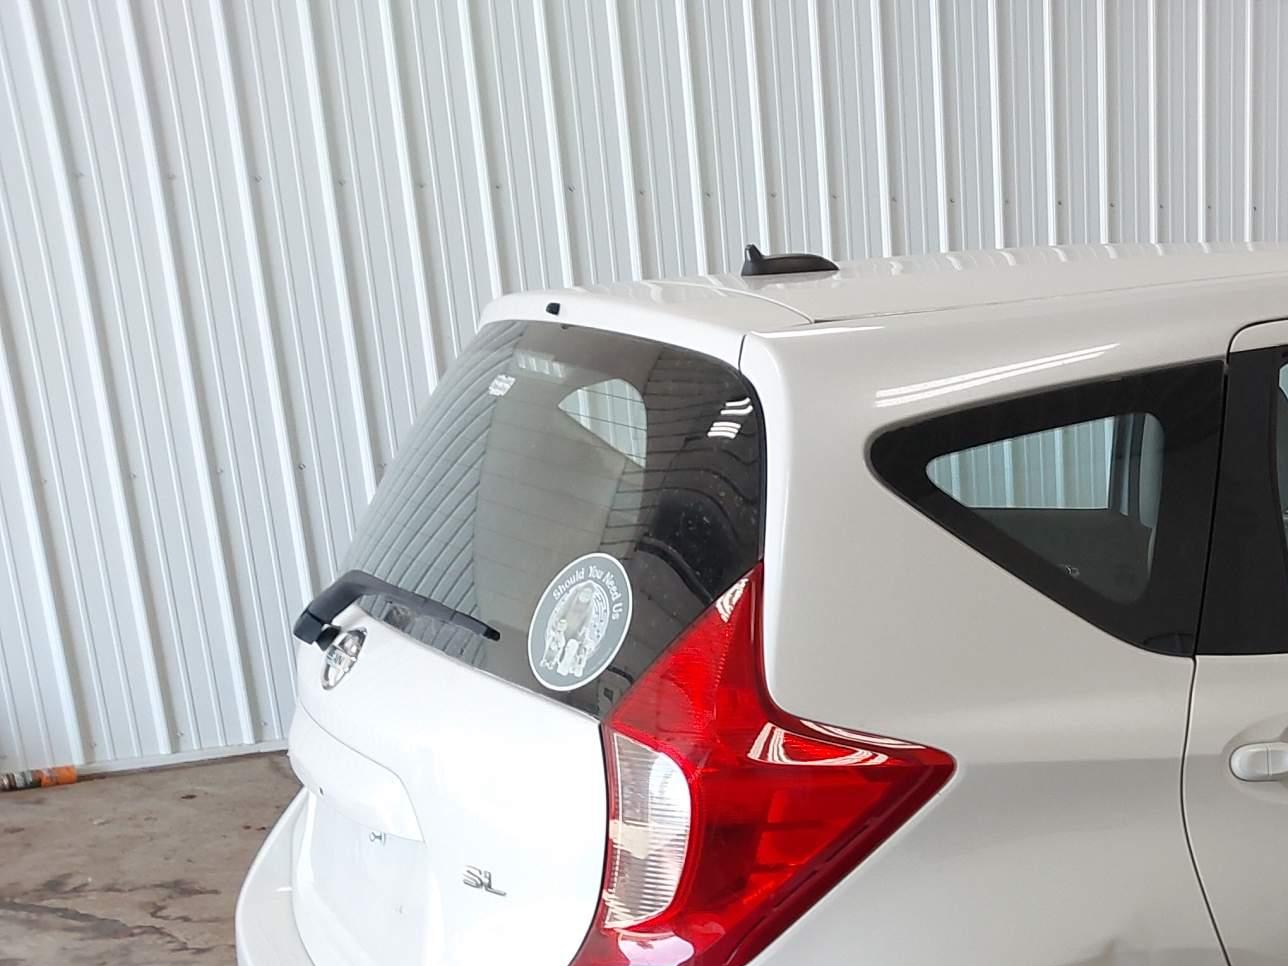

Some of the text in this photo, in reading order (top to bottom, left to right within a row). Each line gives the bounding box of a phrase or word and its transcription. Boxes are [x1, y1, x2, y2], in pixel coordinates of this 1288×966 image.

[552, 565, 624, 621] Should You Need Us
[462, 864, 507, 896] SL
